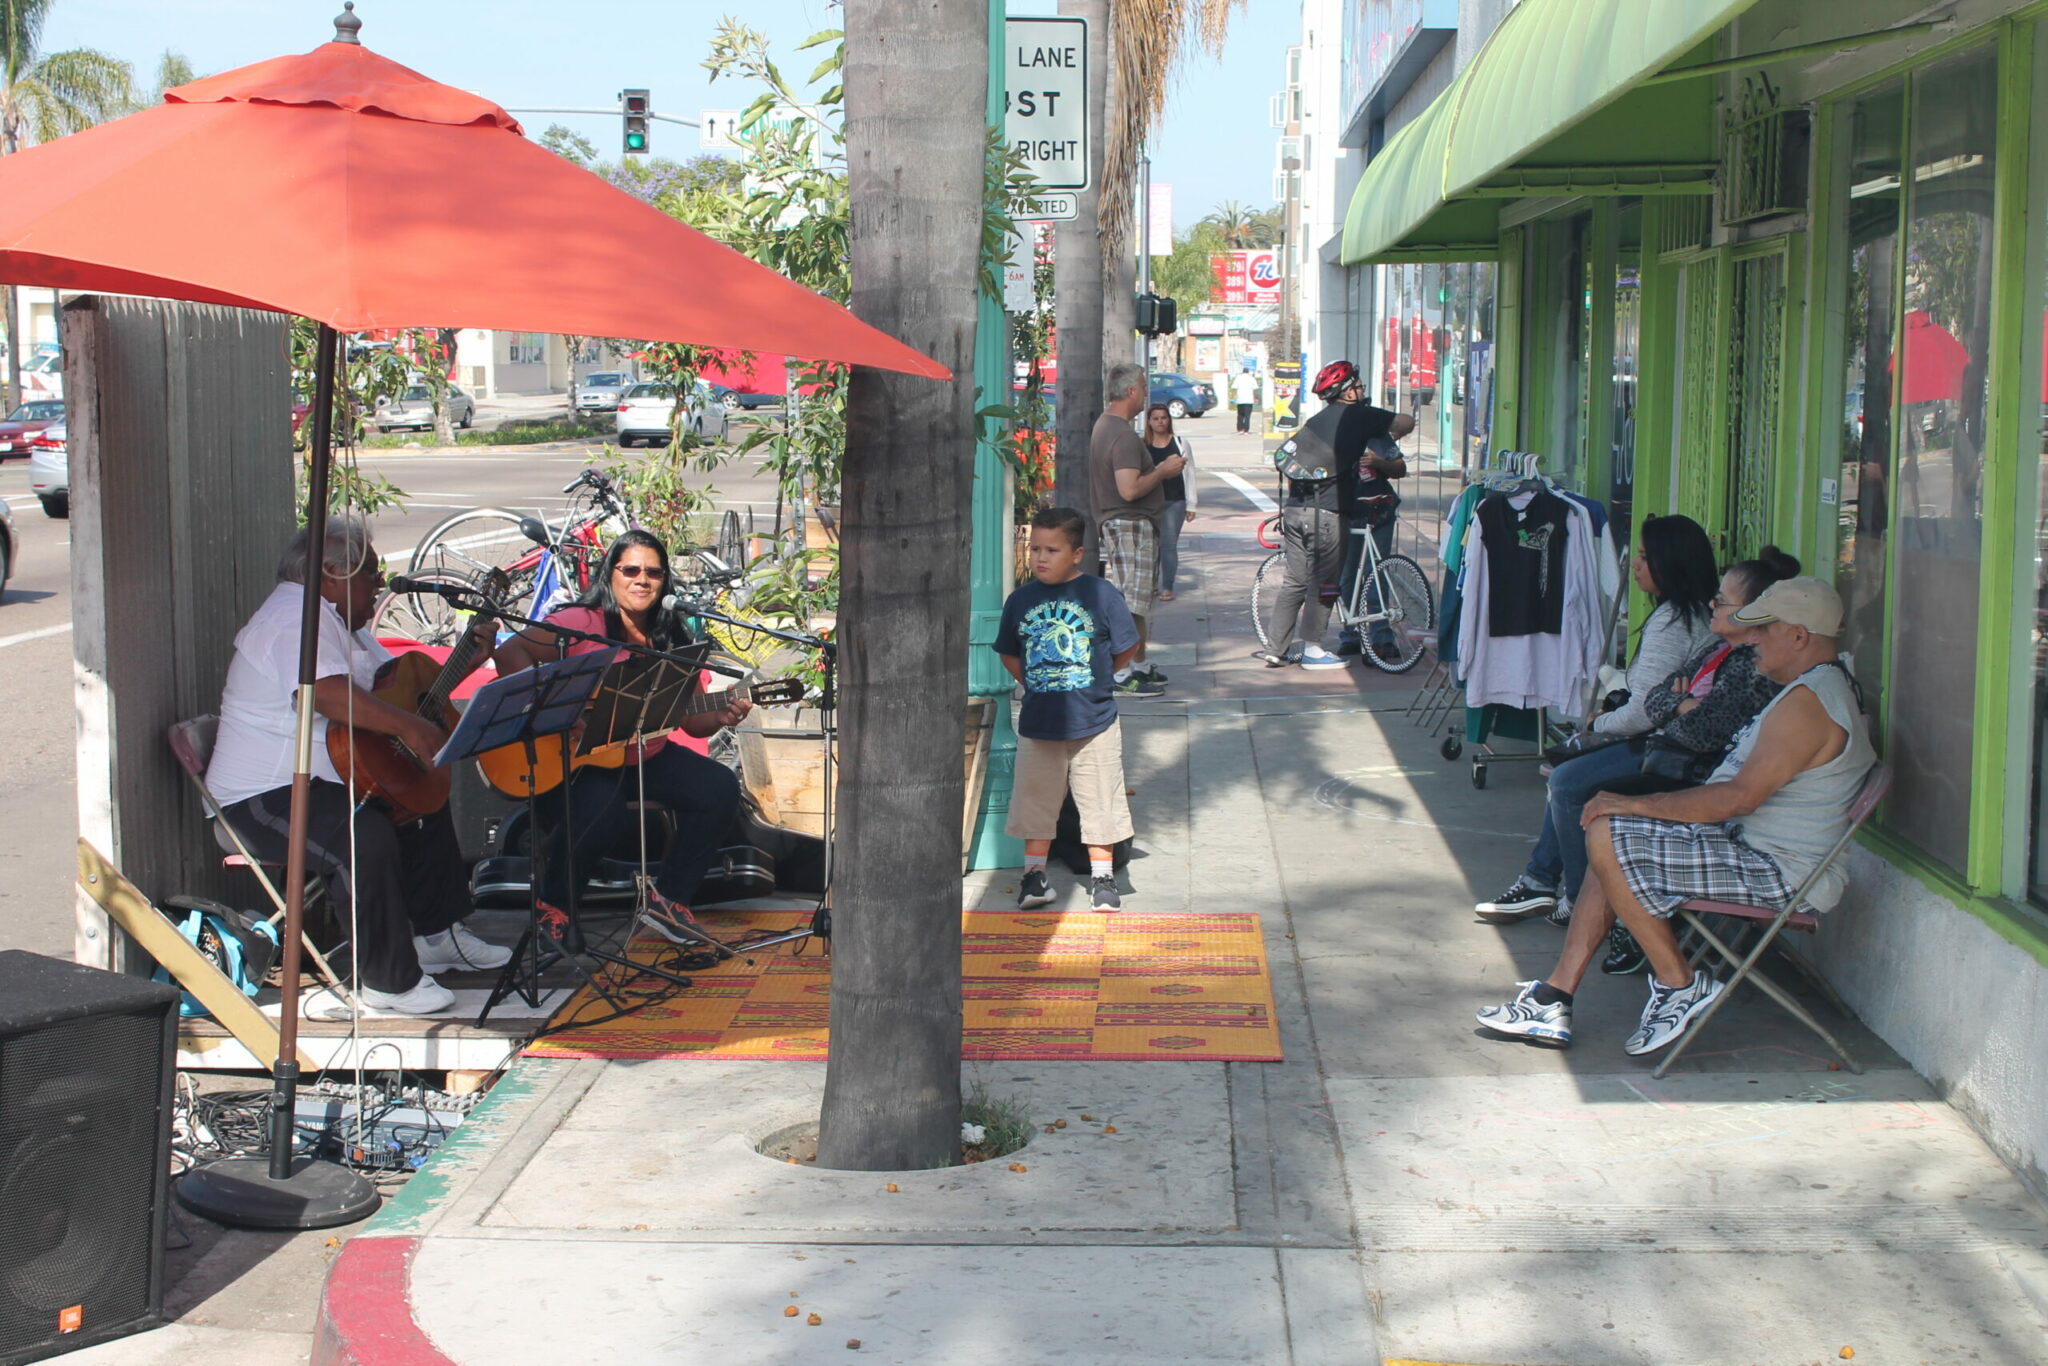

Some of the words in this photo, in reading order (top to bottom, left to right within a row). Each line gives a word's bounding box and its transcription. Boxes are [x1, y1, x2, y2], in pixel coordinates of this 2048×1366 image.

[1018, 47, 1076, 68] LANE
[1005, 91, 1061, 117] ST
[1018, 140, 1078, 161] RIGHT
[1008, 271, 1025, 281] 6AM
